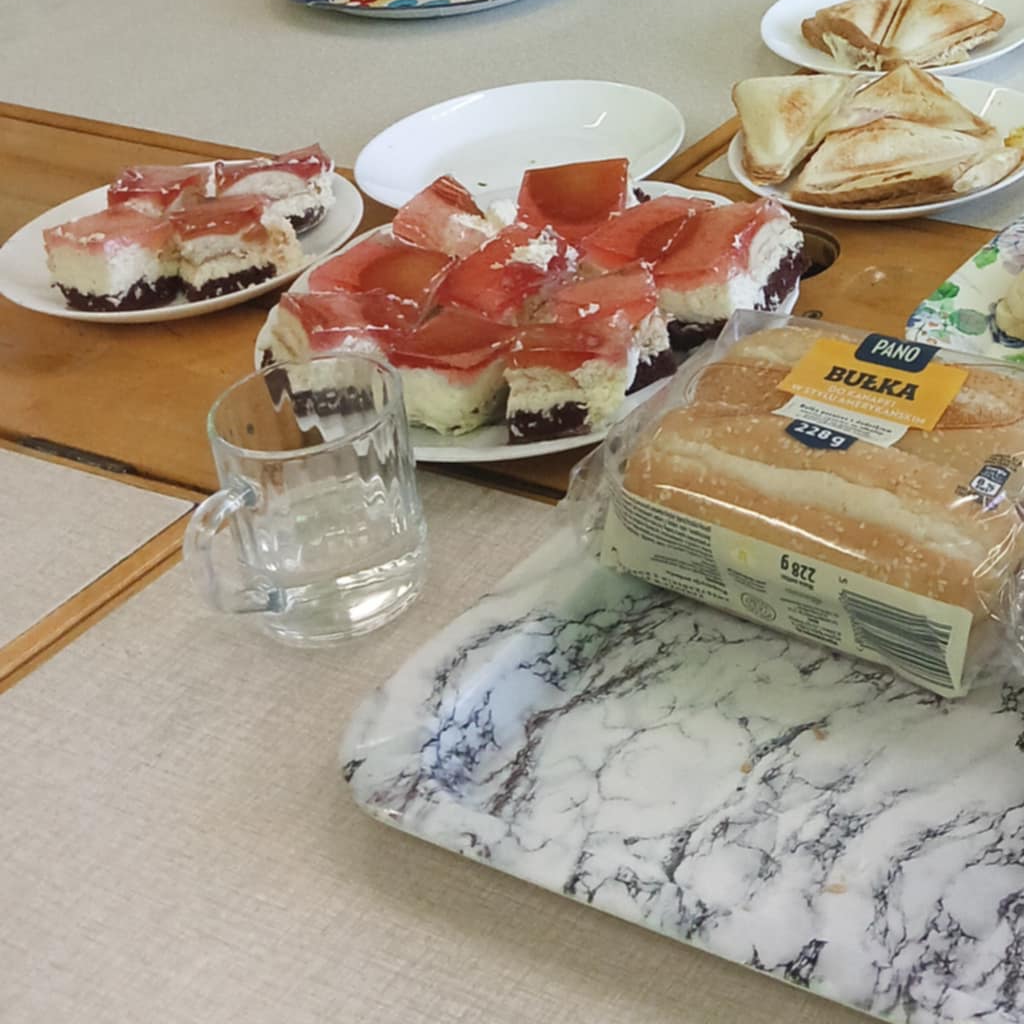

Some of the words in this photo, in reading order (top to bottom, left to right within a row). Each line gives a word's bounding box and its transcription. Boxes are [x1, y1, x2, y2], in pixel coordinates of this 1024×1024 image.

[871, 339, 922, 363] PANO
[824, 365, 920, 401] BUŁKA
[793, 422, 832, 441] 228
[829, 435, 846, 448] g
[780, 554, 790, 571] g
[791, 562, 816, 584] 228
